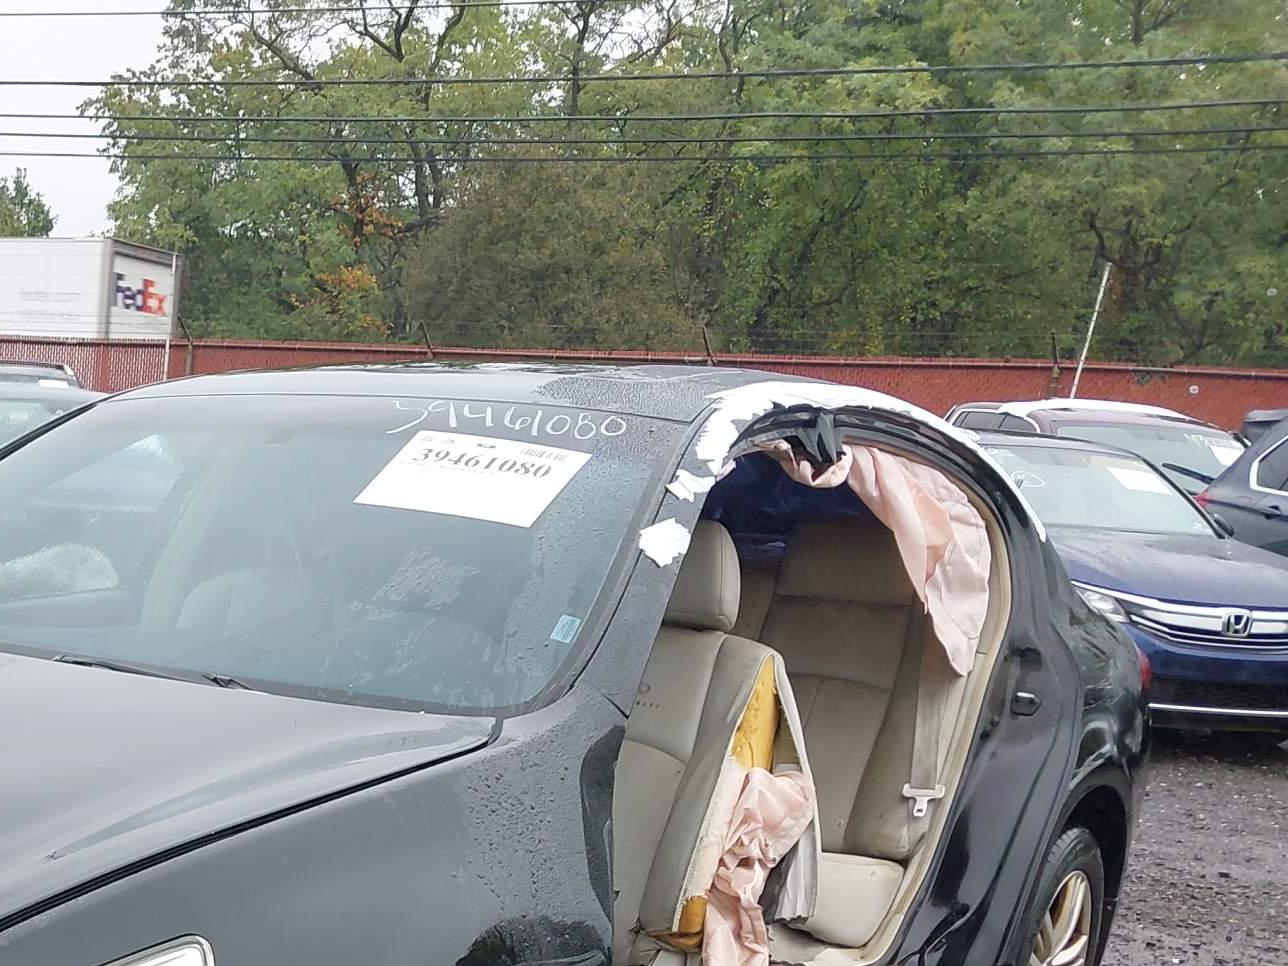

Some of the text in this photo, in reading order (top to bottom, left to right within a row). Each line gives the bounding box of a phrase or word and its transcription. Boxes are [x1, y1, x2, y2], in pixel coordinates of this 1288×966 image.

[112, 272, 168, 316] FedEx
[385, 400, 627, 440] 39461080
[411, 447, 553, 479] 39461080
